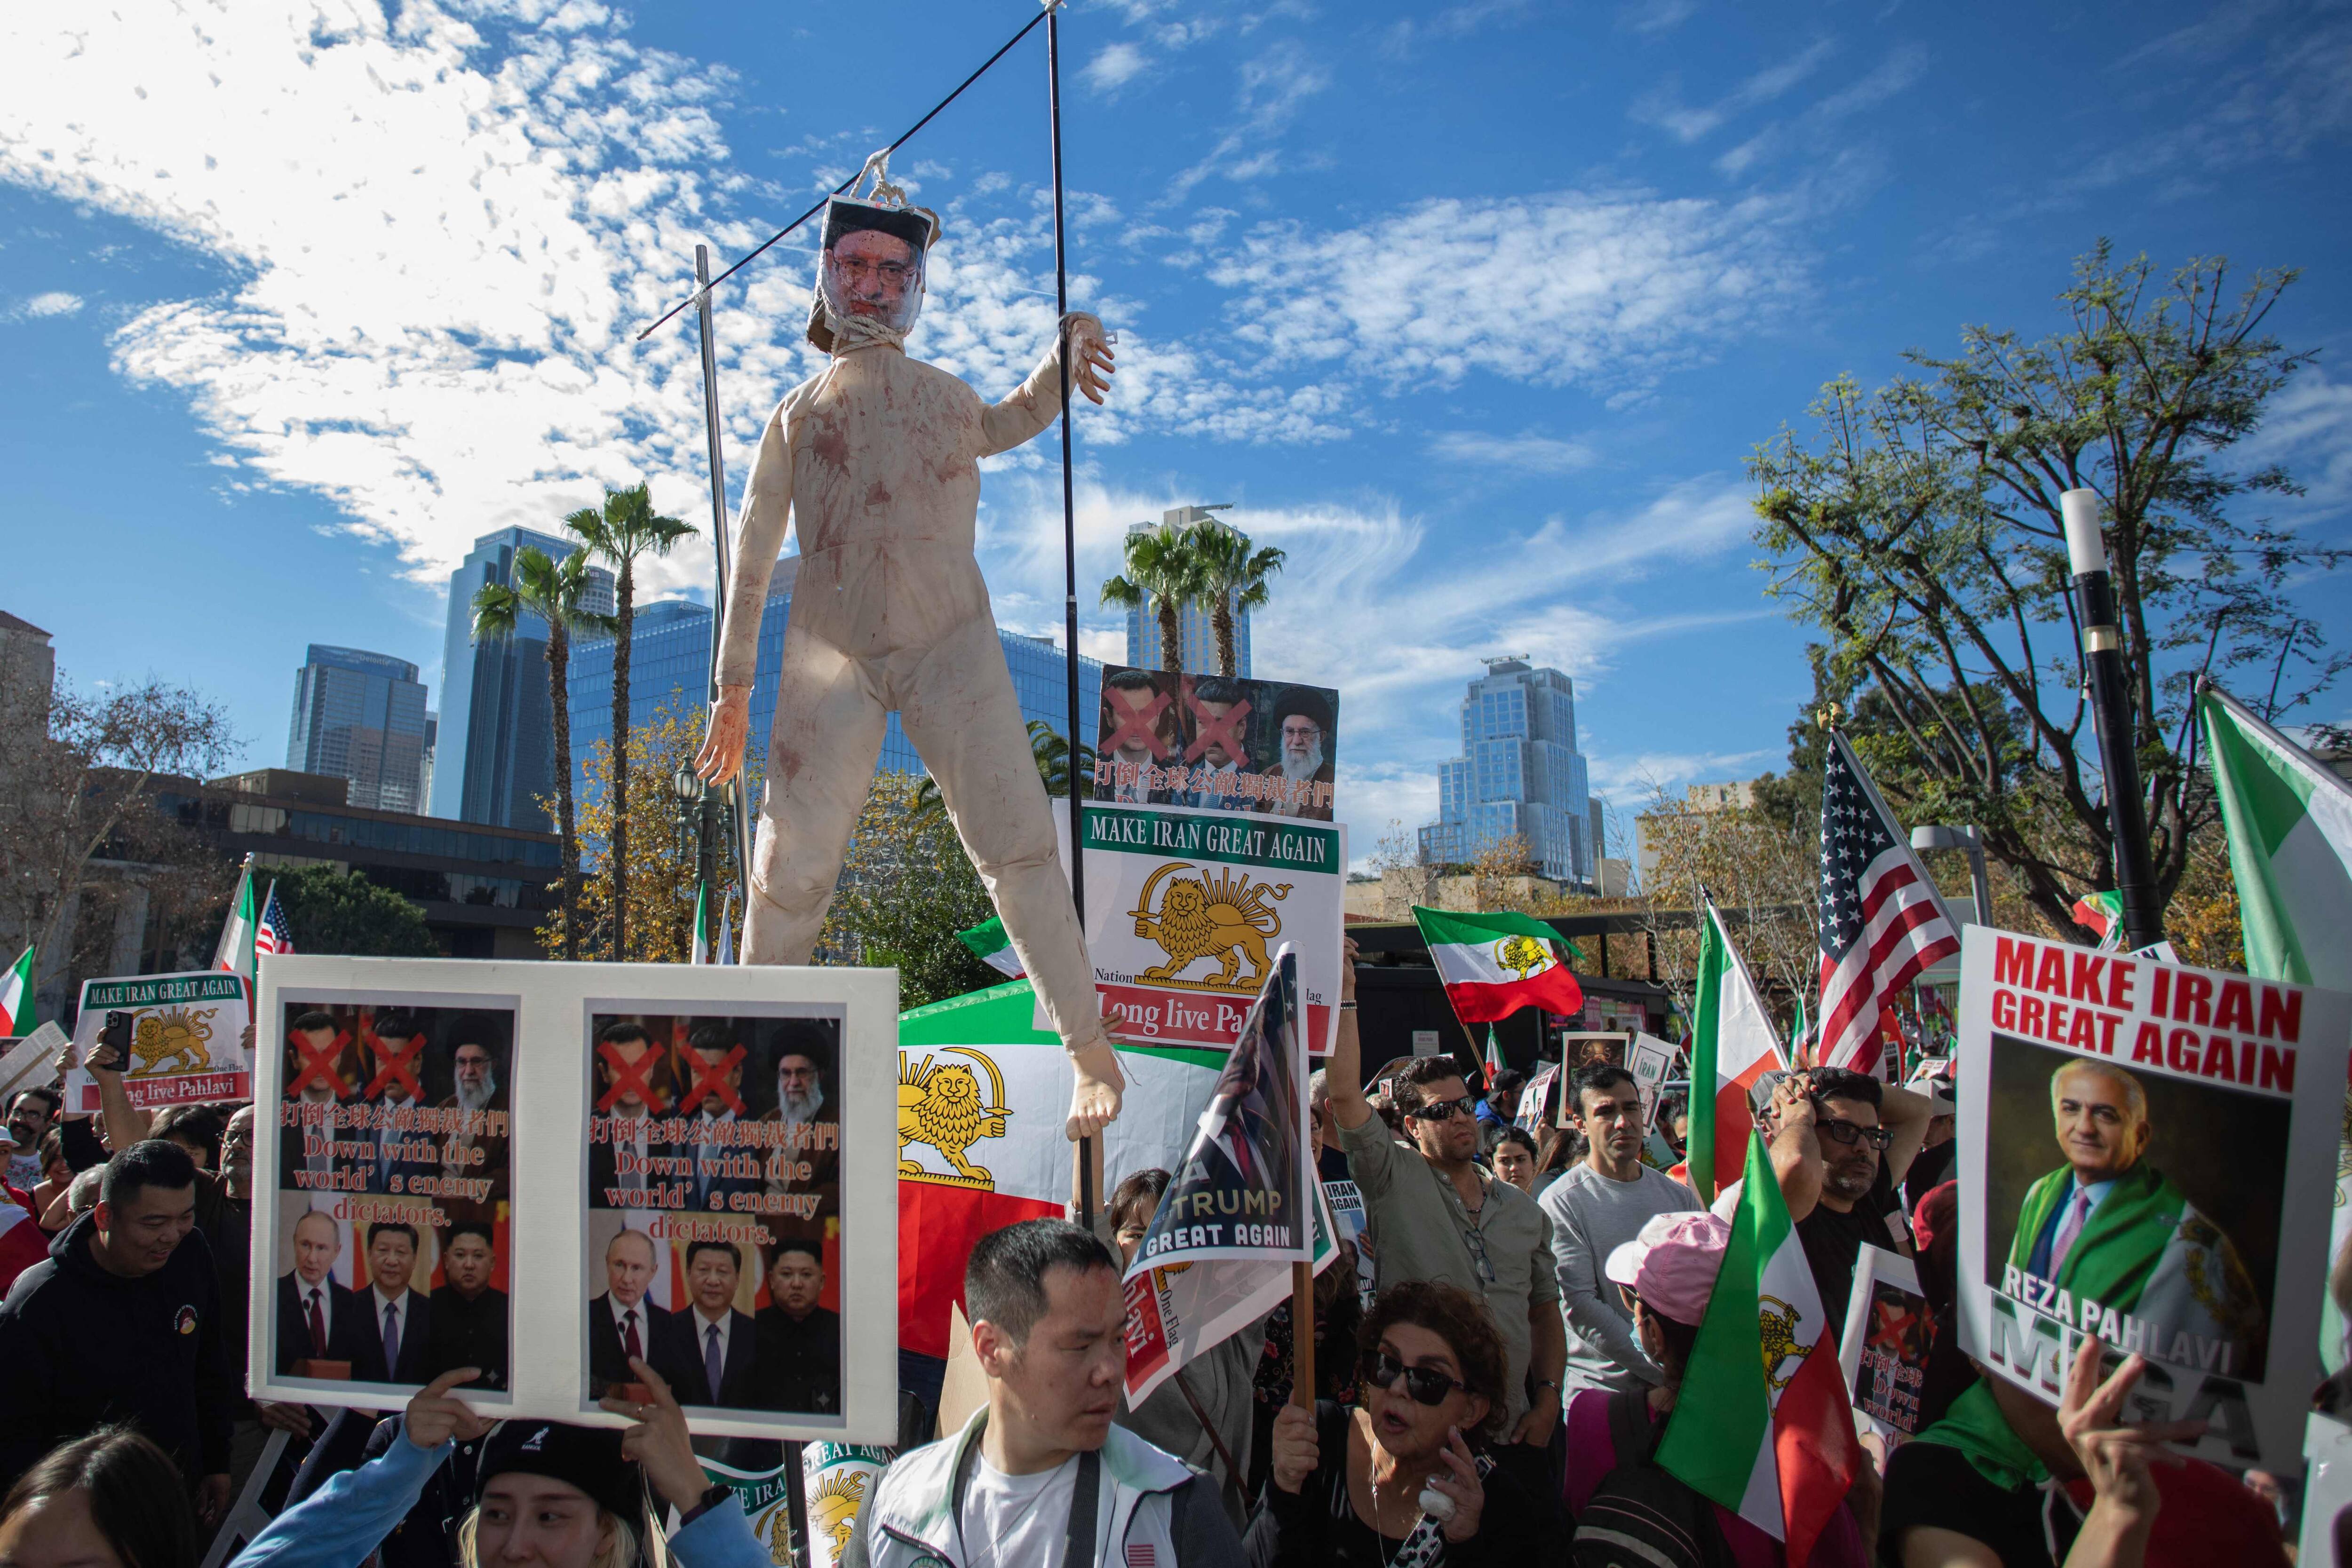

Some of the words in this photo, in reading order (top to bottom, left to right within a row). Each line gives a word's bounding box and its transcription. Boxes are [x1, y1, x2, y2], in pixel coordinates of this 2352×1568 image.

[359, 654, 389, 666] Deloitte
[1090, 815, 1147, 845] MAKE
[1152, 820, 1201, 850] IRAN
[1206, 825, 1265, 856] GREAT
[1268, 833, 1326, 864] AGAIN
[90, 987, 123, 1004] MAKE
[126, 984, 156, 1002] IRAN
[159, 982, 199, 999] GREAT
[201, 980, 236, 997] AGAIN
[1094, 967, 1133, 984] Nation
[1306, 988, 1322, 1006] lag
[1993, 935, 2137, 1013] MAKE
[2150, 966, 2303, 1044] IRAN
[1097, 991, 1161, 1036] Long
[1164, 998, 1210, 1031] live
[1991, 989, 2123, 1057] GREAT
[2130, 1022, 2296, 1094] AGAIN
[229, 1063, 244, 1072] Flag
[126, 1089, 144, 1107] ng
[146, 1084, 175, 1101] live
[177, 1077, 235, 1098] Pahlavi
[303, 1134, 376, 1160] Down
[381, 1137, 438, 1164] with
[444, 1139, 485, 1166] the
[614, 1151, 694, 1177] Down
[700, 1153, 761, 1180] with
[765, 1154, 812, 1181] the
[407, 1176, 494, 1204] enemy
[1171, 1189, 1282, 1220] TRUMP
[1326, 1182, 1358, 1198] IRAN
[1329, 1196, 1362, 1211] AGAIN
[333, 1196, 452, 1227] dictators.
[729, 1193, 822, 1220] enemy
[648, 1215, 778, 1246] dictators.
[1145, 1224, 1224, 1258] GREAT
[1234, 1224, 1290, 1247] AGAIN
[1160, 1289, 1173, 1317] One
[1166, 1314, 1180, 1350] Flag
[2005, 1263, 2074, 1325] REZA
[2080, 1298, 2233, 1376] PAHLAVI
[1871, 1376, 1920, 1411] Down
[754, 1476, 787, 1506] IRA
[803, 1441, 853, 1476] GREAT
